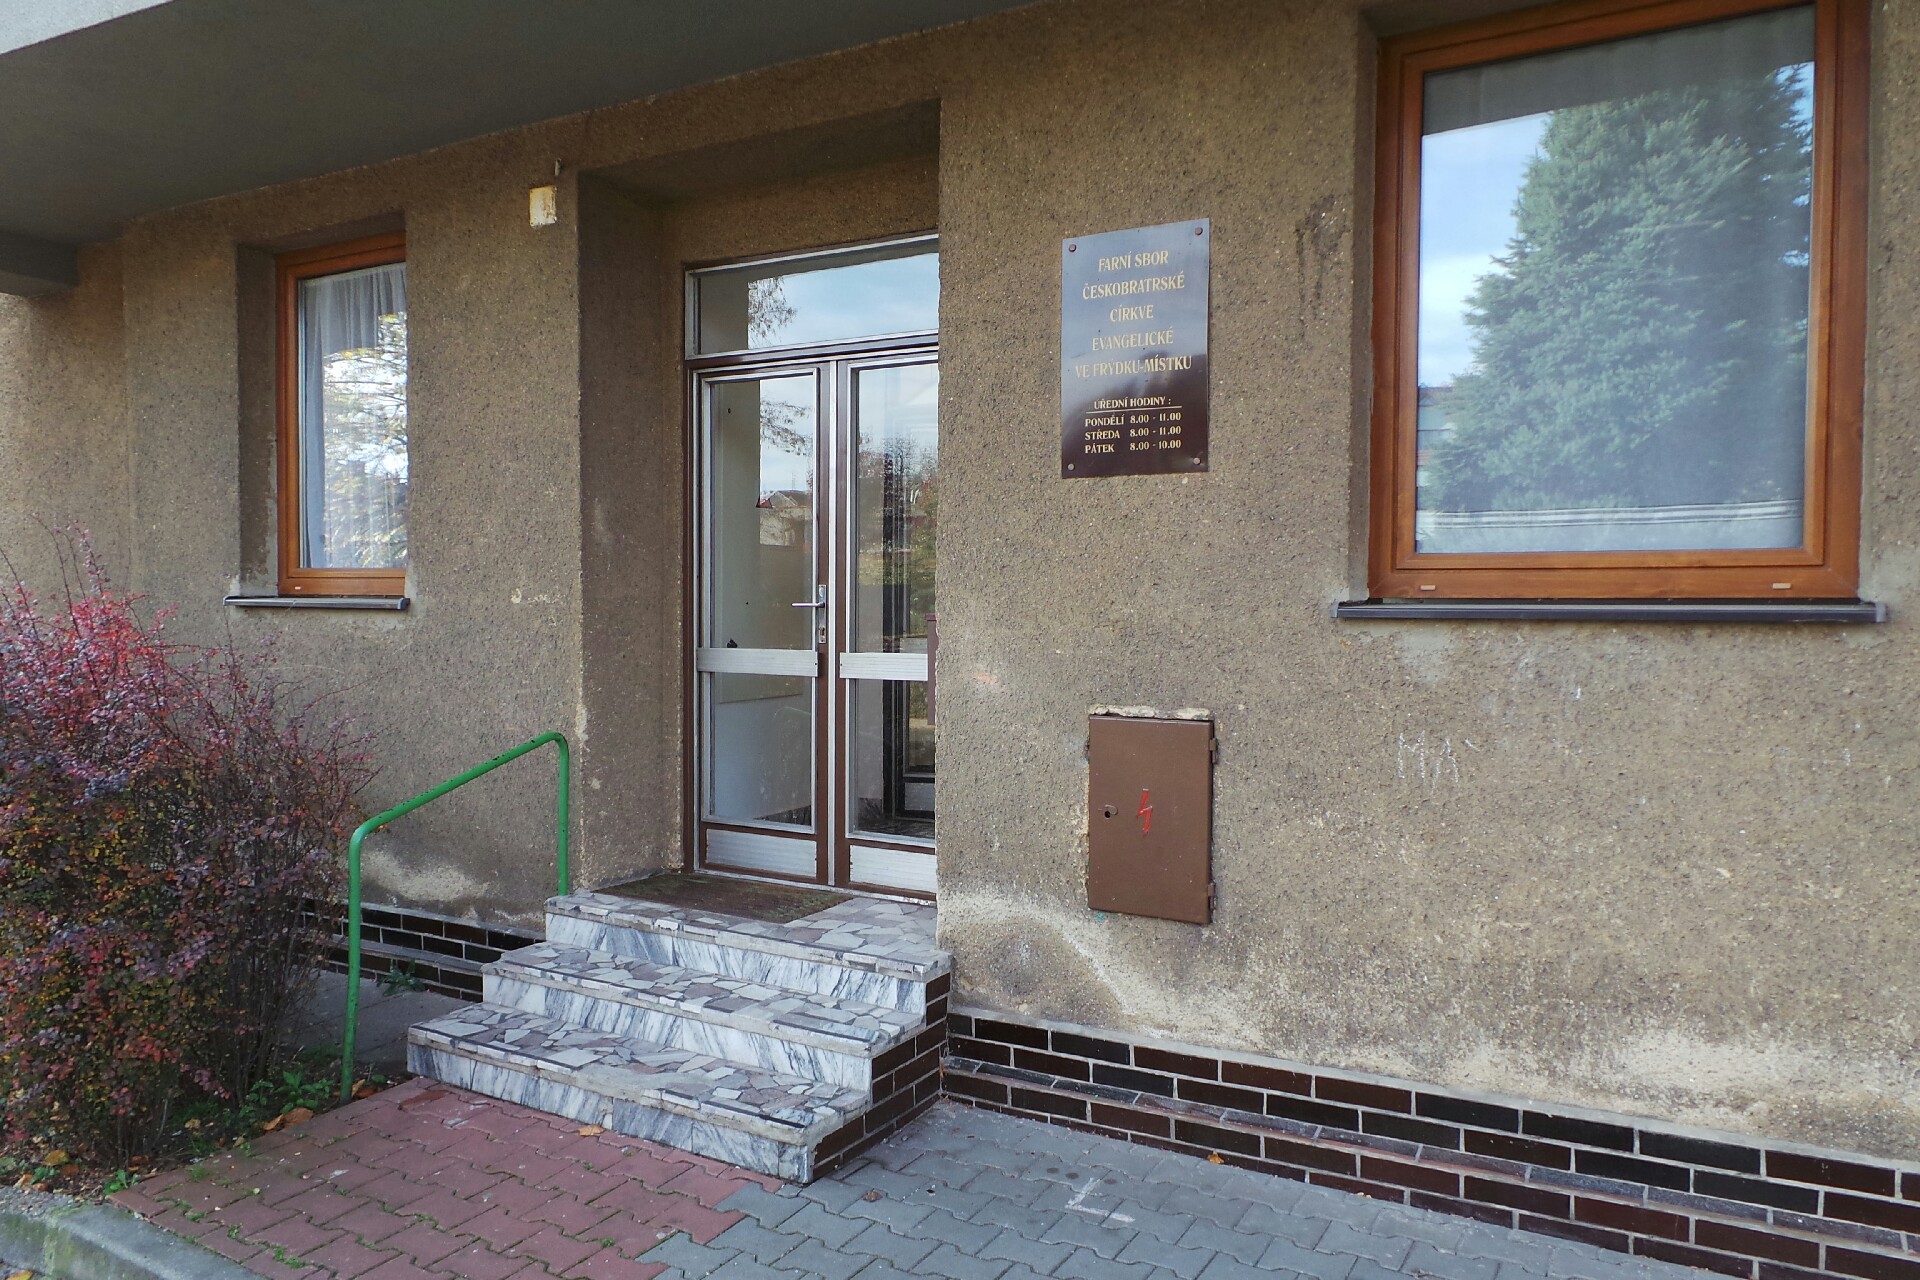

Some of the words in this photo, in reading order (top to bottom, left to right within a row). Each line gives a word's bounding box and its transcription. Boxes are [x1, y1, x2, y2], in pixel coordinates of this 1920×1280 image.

[1098, 251, 1131, 272] FARNÍ
[1134, 250, 1169, 267] SBOR
[1082, 271, 1185, 300] ČESKOBRATRSKÉ
[1109, 304, 1154, 322] CÍRKVE
[1092, 326, 1174, 351] EVANGELICKÉ
[1075, 364, 1090, 378] VE
[1093, 354, 1192, 377] FRÝDKU-MÍSTKU
[1130, 396, 1166, 407] HODINY
[1085, 413, 1125, 427] PONDĚLÍ
[1130, 414, 1150, 424] 8.00
[1159, 412, 1182, 422] 11.00
[1085, 428, 1121, 441] STŘEDA
[1130, 427, 1150, 438] 8.00
[1159, 425, 1182, 436] 11.00
[1085, 443, 1115, 454] PÁTEK
[1130, 442, 1150, 451] 8.00
[1158, 439, 1182, 450] 10.00
